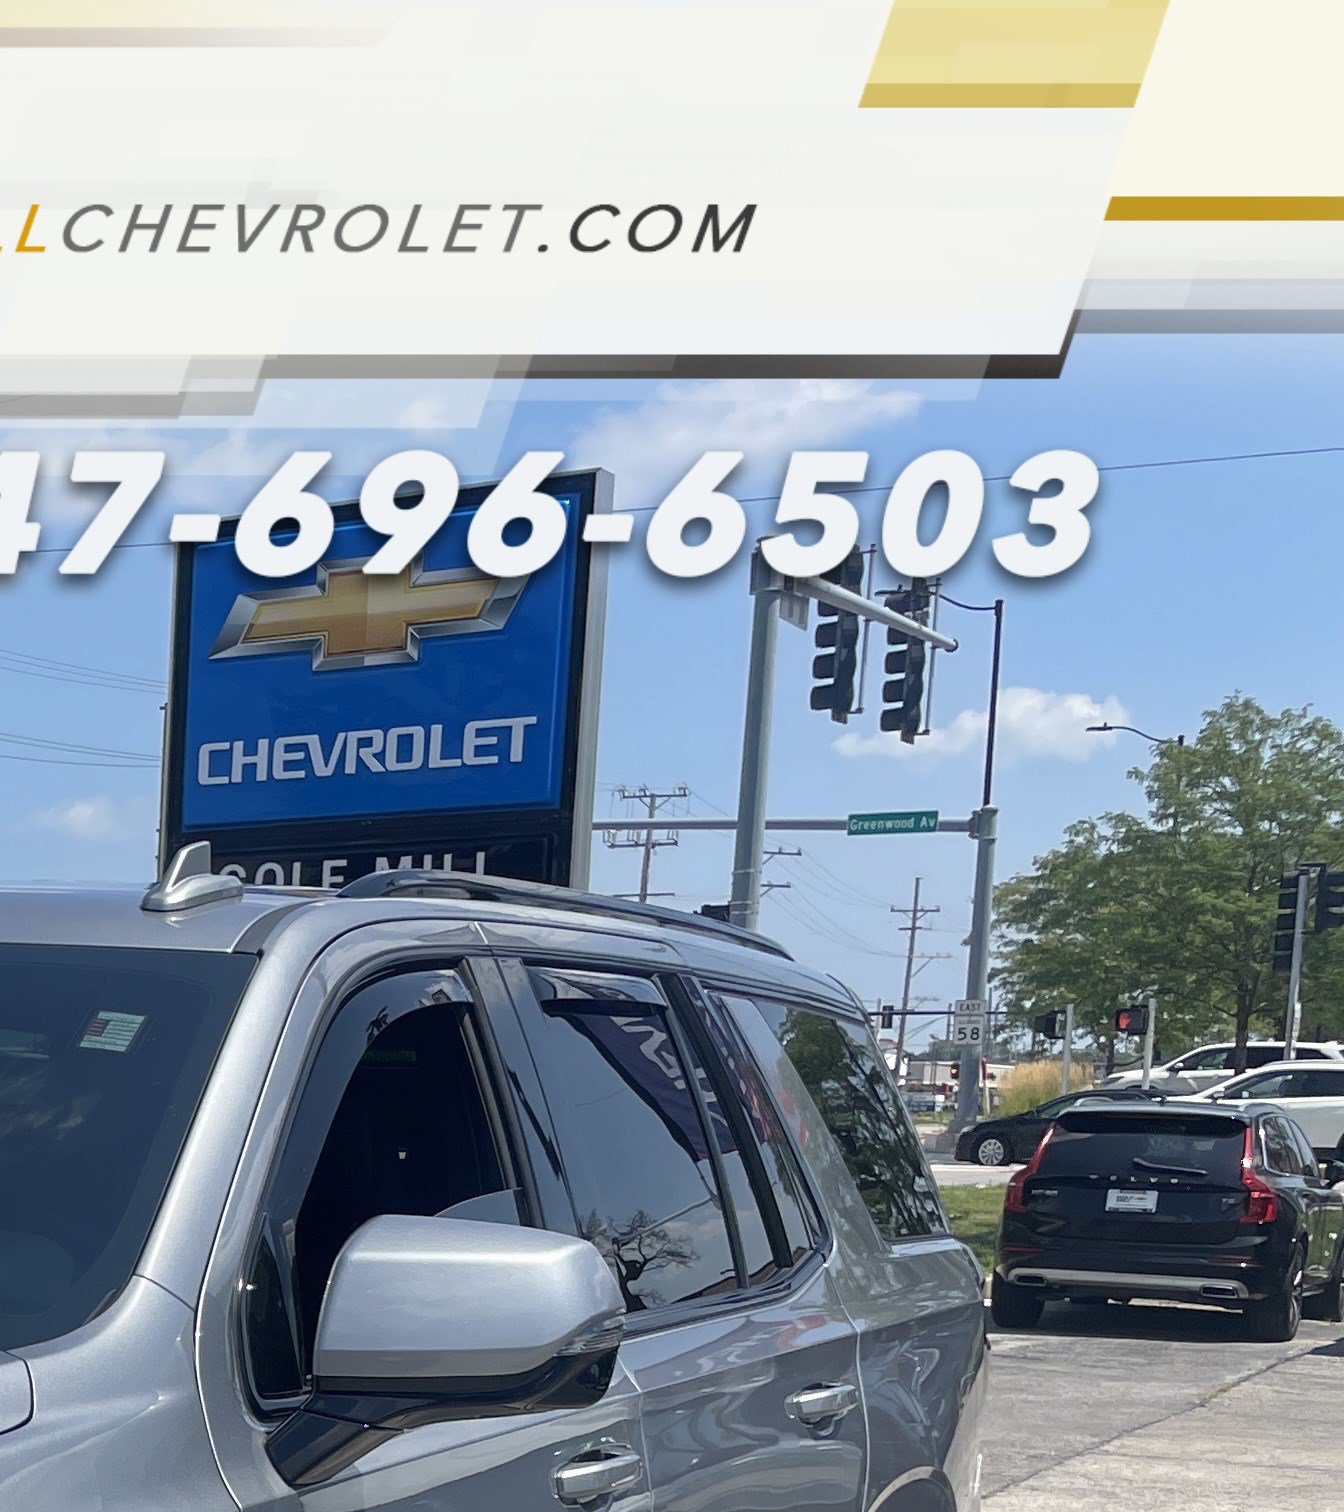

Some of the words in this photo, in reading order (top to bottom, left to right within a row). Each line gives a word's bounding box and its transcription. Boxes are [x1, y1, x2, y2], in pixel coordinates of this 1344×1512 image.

[197, 715, 538, 787] CHEVROLET
[849, 816, 914, 831] Greenwood
[920, 815, 936, 828] Av
[959, 1003, 981, 1011] EAST
[957, 1027, 980, 1041] 58
